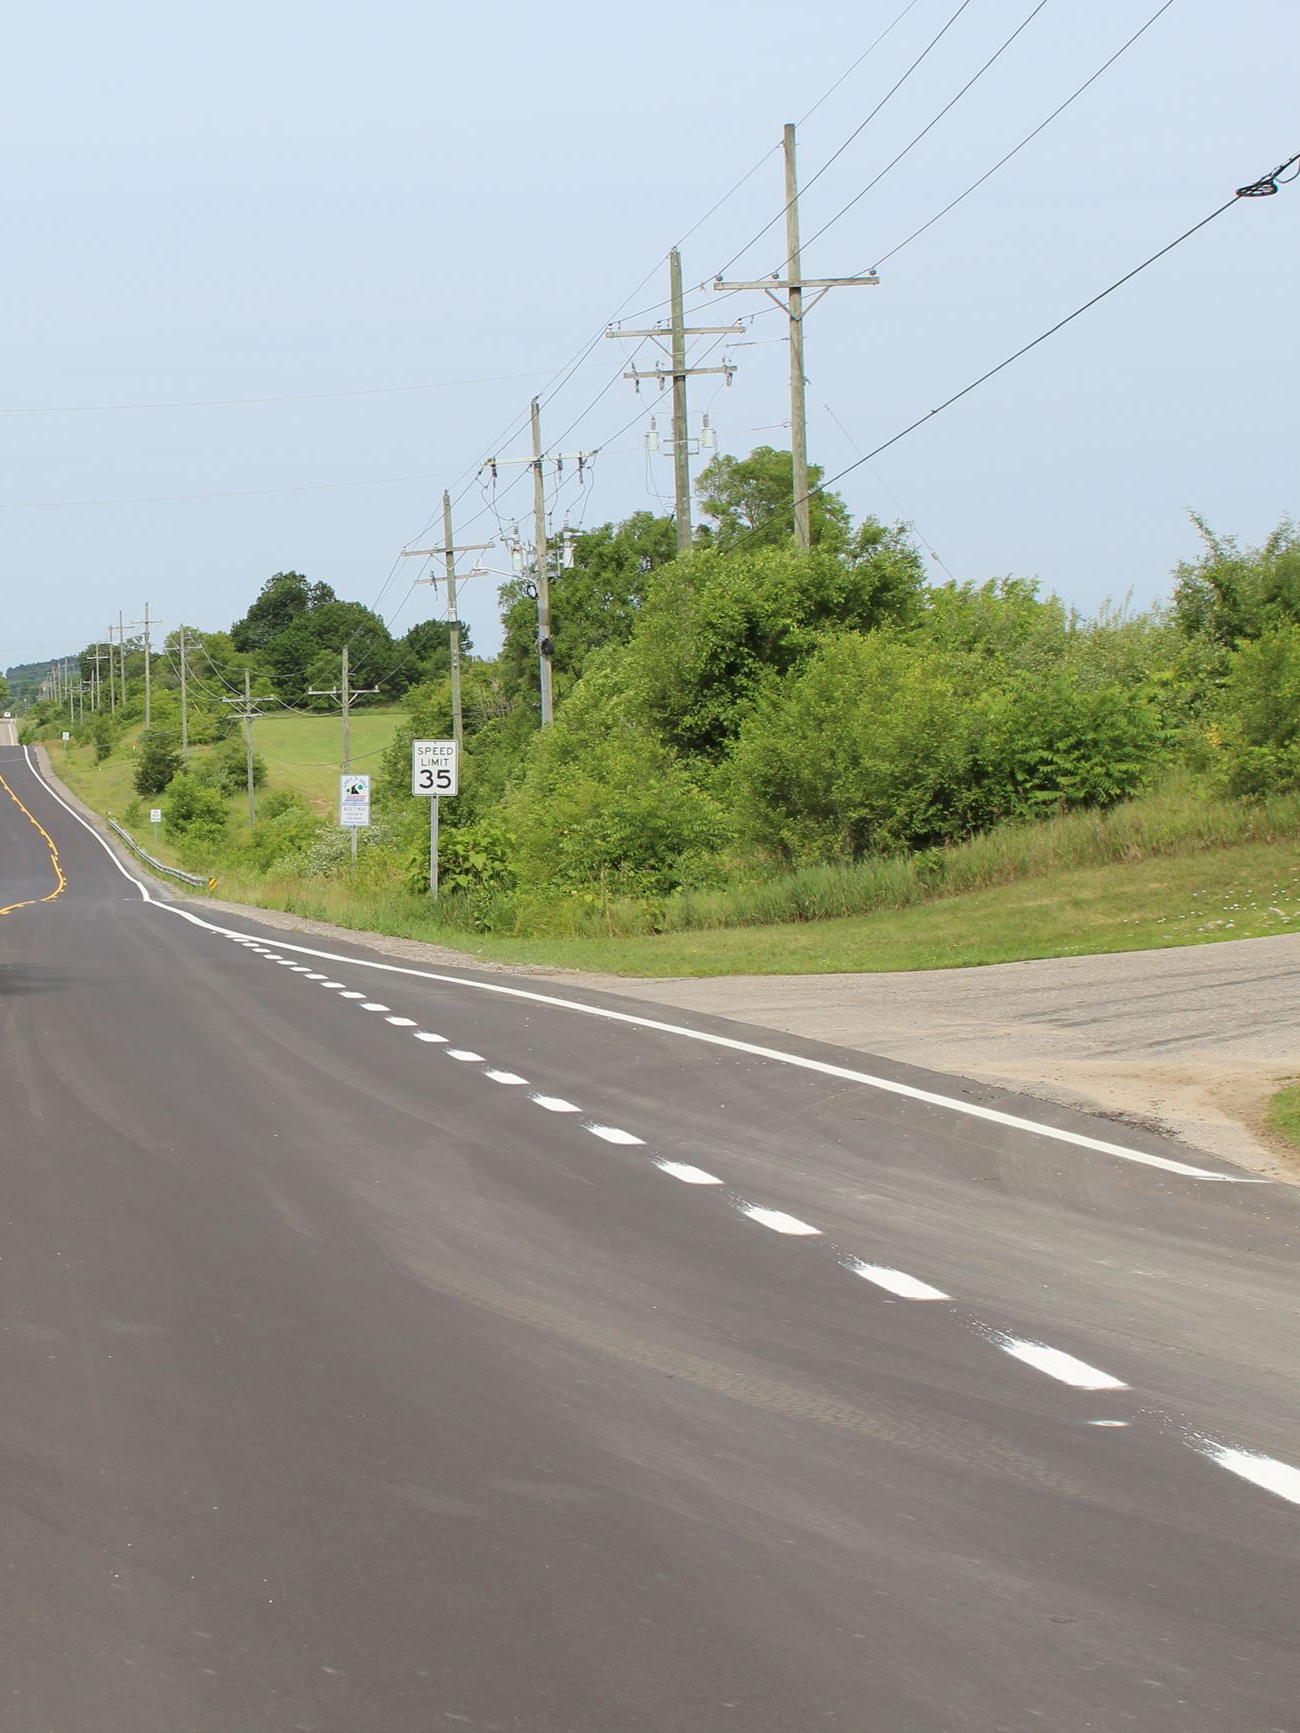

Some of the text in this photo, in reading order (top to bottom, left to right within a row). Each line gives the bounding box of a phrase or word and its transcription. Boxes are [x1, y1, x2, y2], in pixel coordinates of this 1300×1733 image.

[417, 746, 454, 756] SPEED
[420, 758, 449, 767] LIMIT
[419, 769, 452, 789] 35
